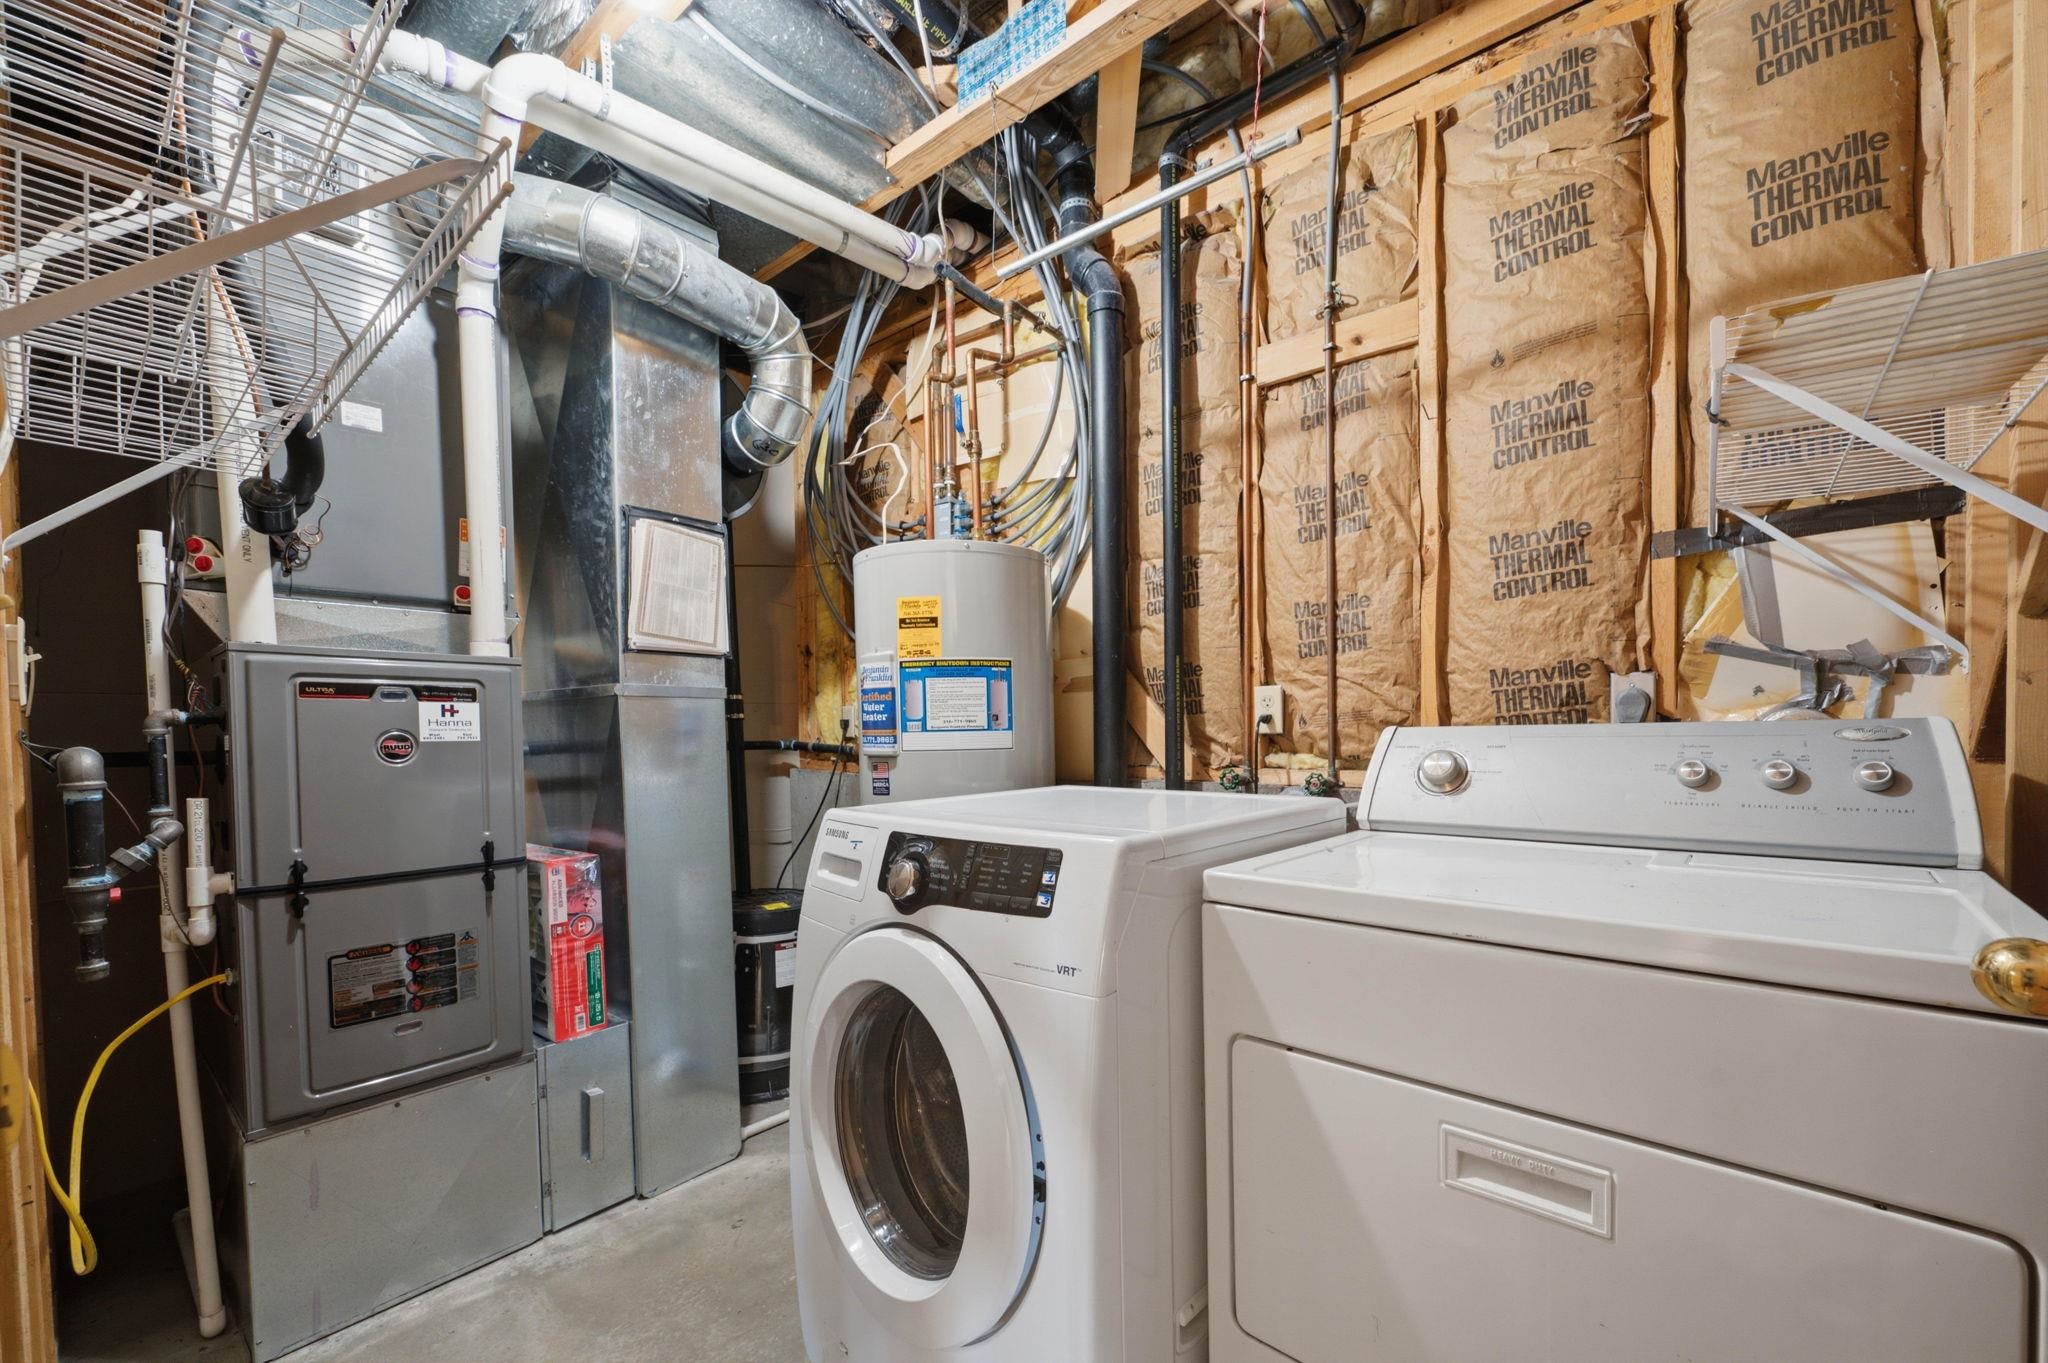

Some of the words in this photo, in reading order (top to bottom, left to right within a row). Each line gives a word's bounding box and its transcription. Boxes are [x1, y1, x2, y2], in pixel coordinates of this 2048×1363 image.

[1756, 18, 1897, 86] CONTROL
[1493, 46, 1598, 107] Manville
[1495, 66, 1597, 128] THERMAL
[1494, 91, 1598, 150] CONTROL
[1746, 129, 1891, 194] Manville
[1489, 181, 1595, 238] Manville
[1748, 154, 1891, 220] THERMAL
[1491, 201, 1595, 260] THERMAL
[1750, 187, 1892, 247] CONTROL
[1494, 227, 1598, 283] CONTROL
[1490, 379, 1595, 424] Manville
[1491, 398, 1595, 450] THERMAL
[1493, 423, 1597, 471] CONTROL
[1488, 518, 1593, 557] Manville
[1490, 535, 1594, 581] THERMAL
[1492, 561, 1596, 602] CONTROL
[1489, 659, 1592, 688] Manville
[1491, 681, 1594, 714] THERMAL
[427, 719, 472, 727] Hanna
[1855, 727, 1888, 735] Whirlpool
[382, 744, 411, 752] RUUD
[825, 828, 849, 840] SAMSUNG
[1041, 896, 1050, 906] 3
